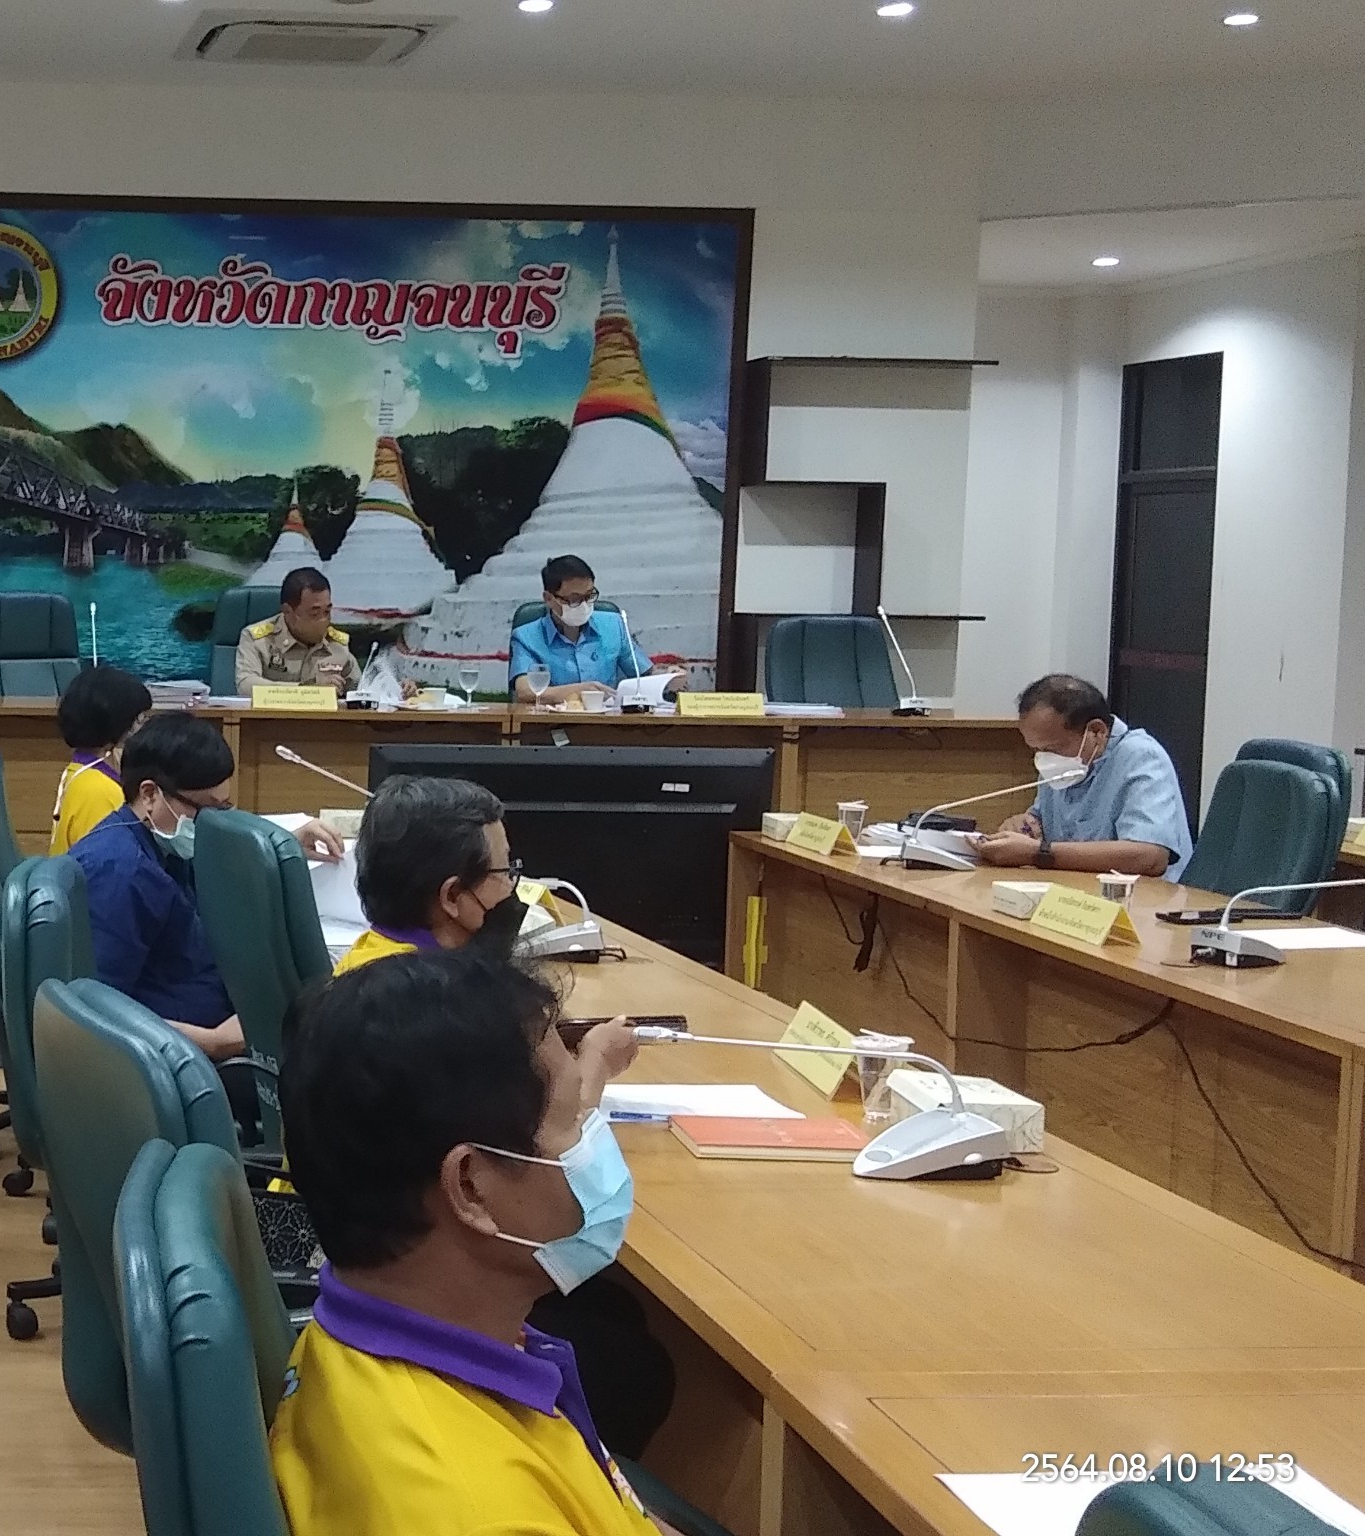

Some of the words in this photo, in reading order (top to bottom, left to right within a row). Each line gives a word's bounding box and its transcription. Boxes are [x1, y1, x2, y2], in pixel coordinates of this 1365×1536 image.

[99, 257, 565, 356] จังหวัดกาญจนบุรี
[1200, 929, 1226, 941] NPE
